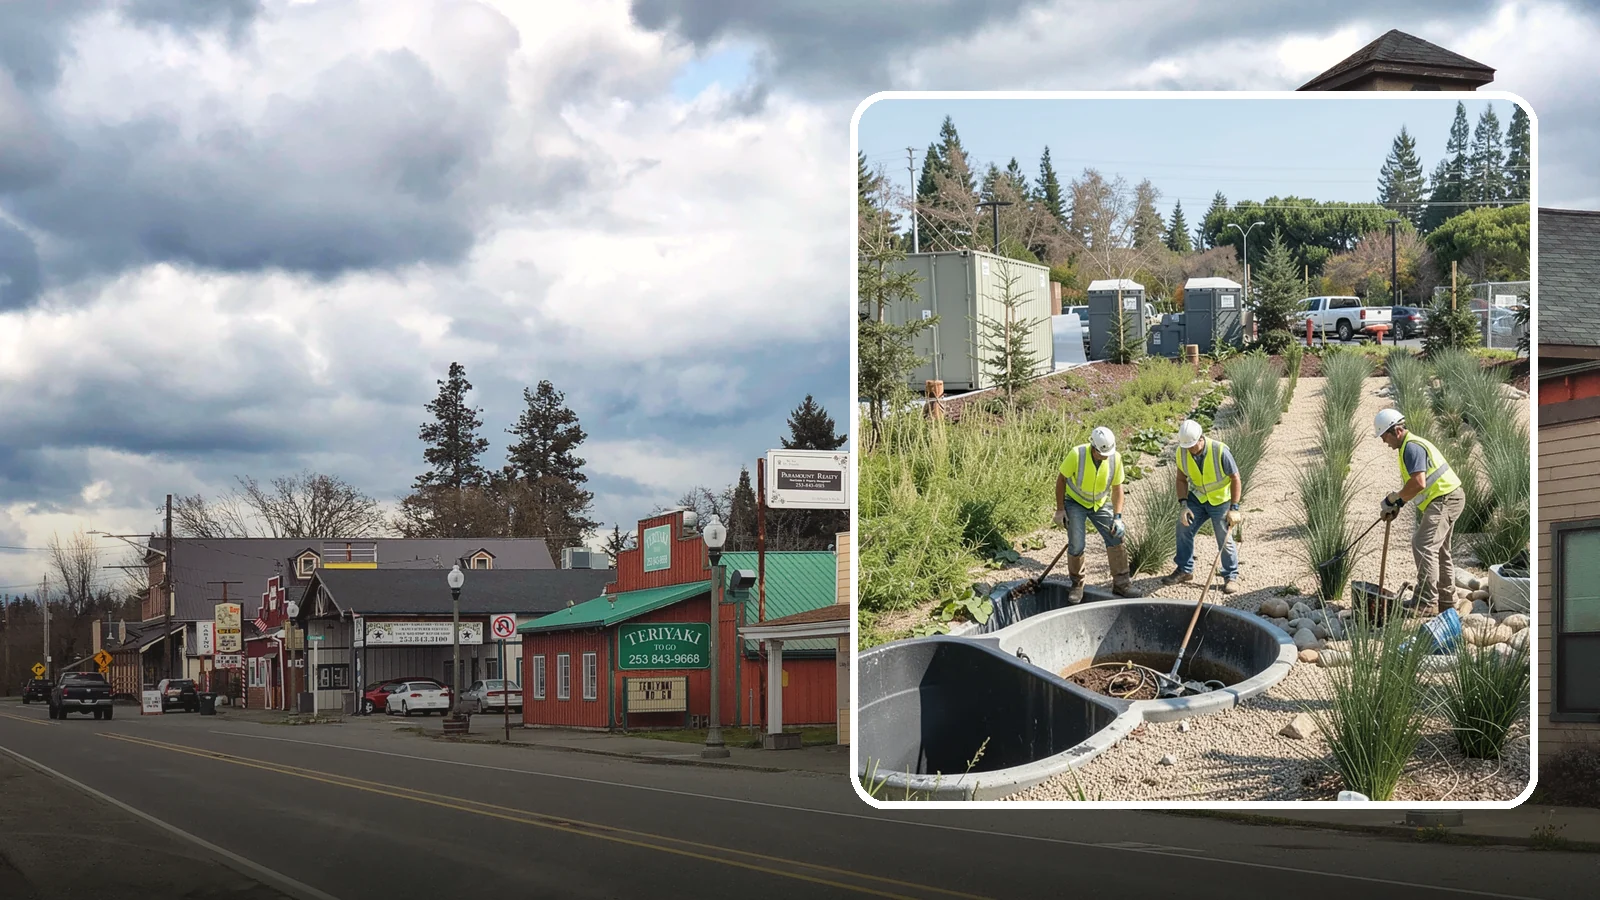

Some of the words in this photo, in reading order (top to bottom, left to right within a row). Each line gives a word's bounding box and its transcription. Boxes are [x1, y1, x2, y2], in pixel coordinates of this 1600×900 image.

[625, 627, 702, 646] TERIYAKI
[629, 655, 648, 664] 253
[651, 654, 700, 664] 843-9668
